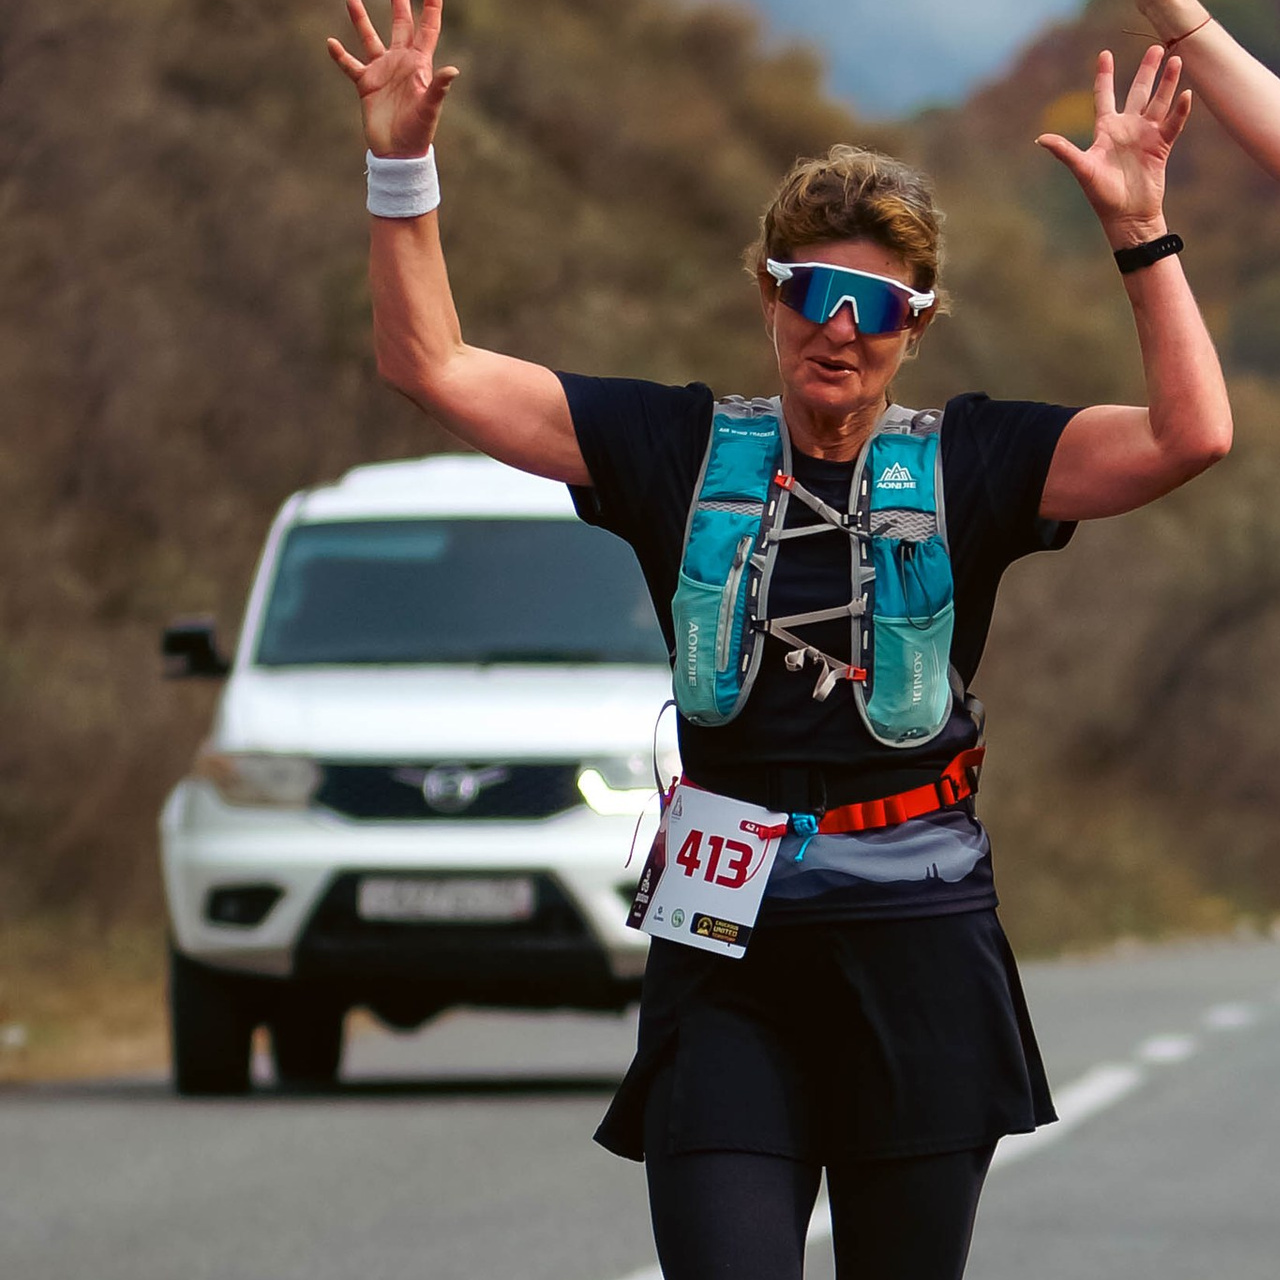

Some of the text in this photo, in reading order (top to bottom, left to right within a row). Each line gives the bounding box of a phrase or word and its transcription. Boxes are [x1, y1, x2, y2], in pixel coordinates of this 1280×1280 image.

[876, 481, 917, 489] AONIJIE
[688, 621, 699, 687] AONIJIE
[676, 829, 753, 889] 413
